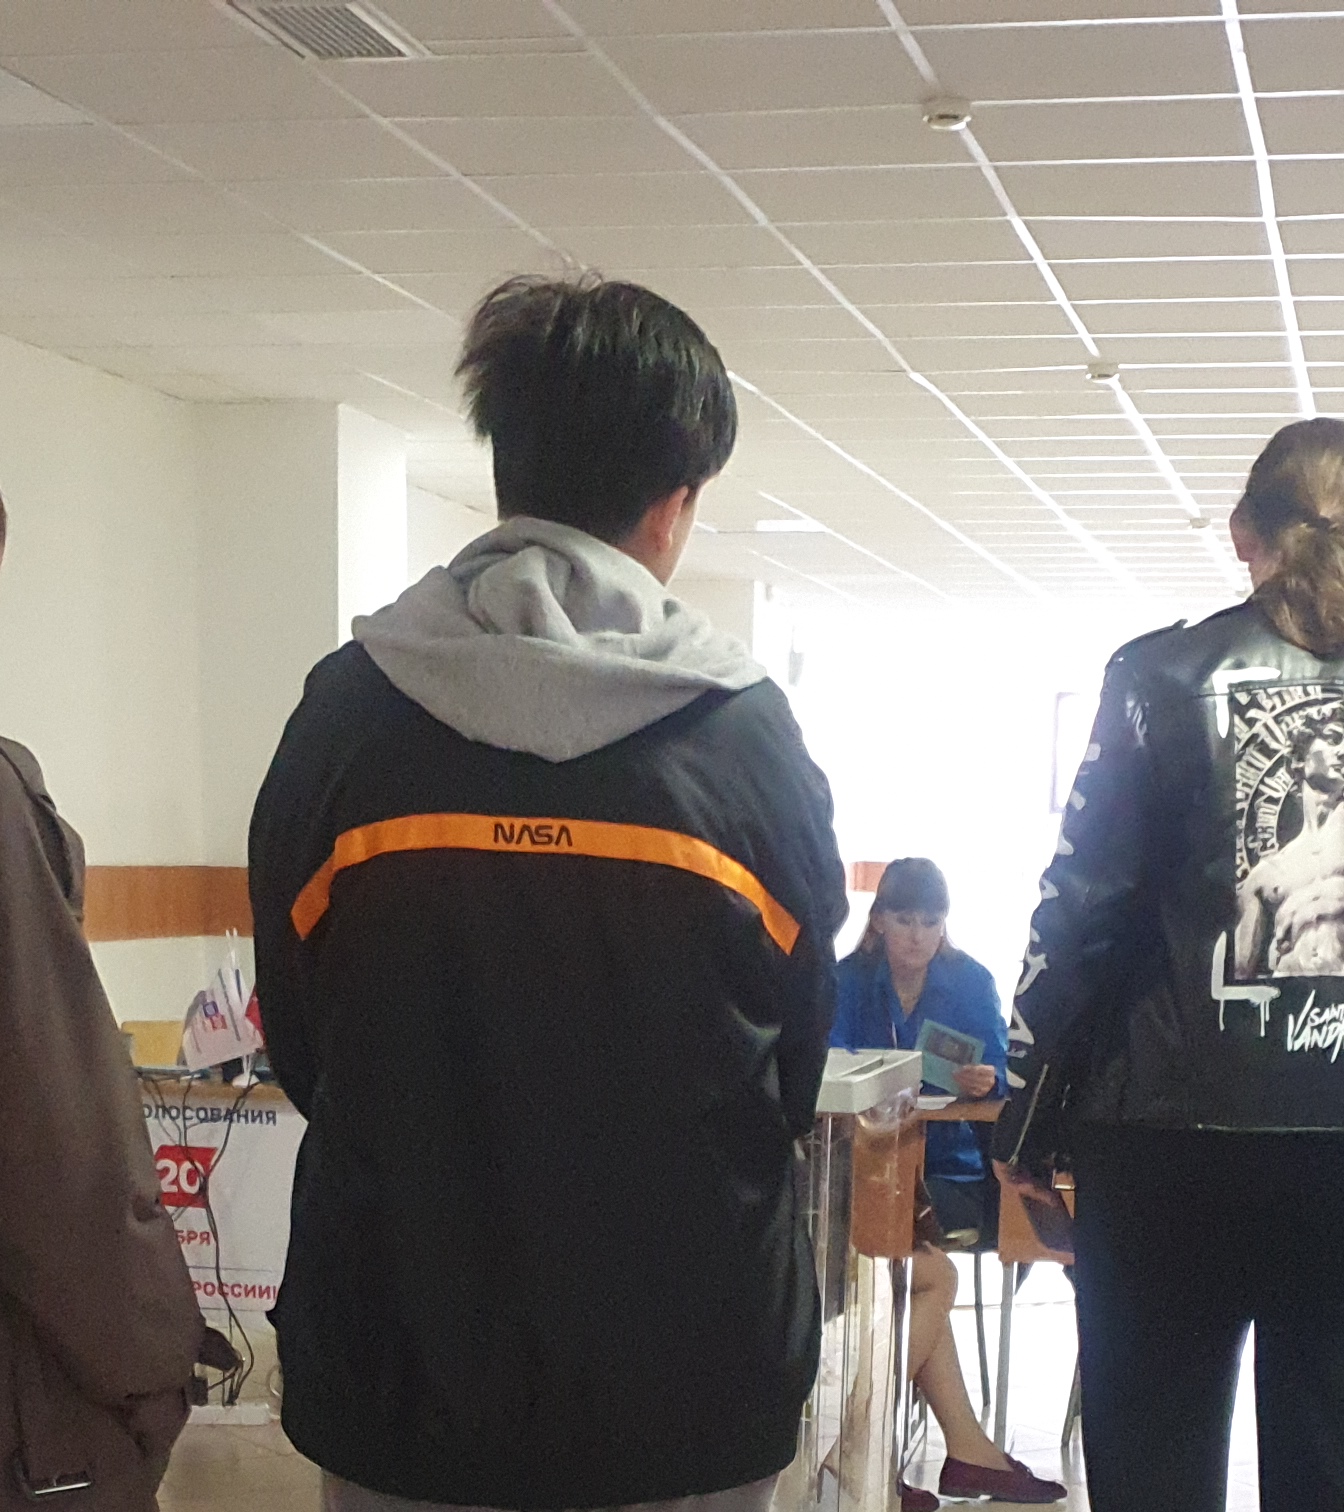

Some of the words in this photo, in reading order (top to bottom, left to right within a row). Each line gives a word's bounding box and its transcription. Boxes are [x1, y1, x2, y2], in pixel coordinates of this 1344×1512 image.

[493, 822, 573, 847] NASA
[143, 1104, 277, 1126] ОЛОСОВАНИЯ
[156, 1159, 205, 1194] 20
[176, 1229, 211, 1246] БРЯ
